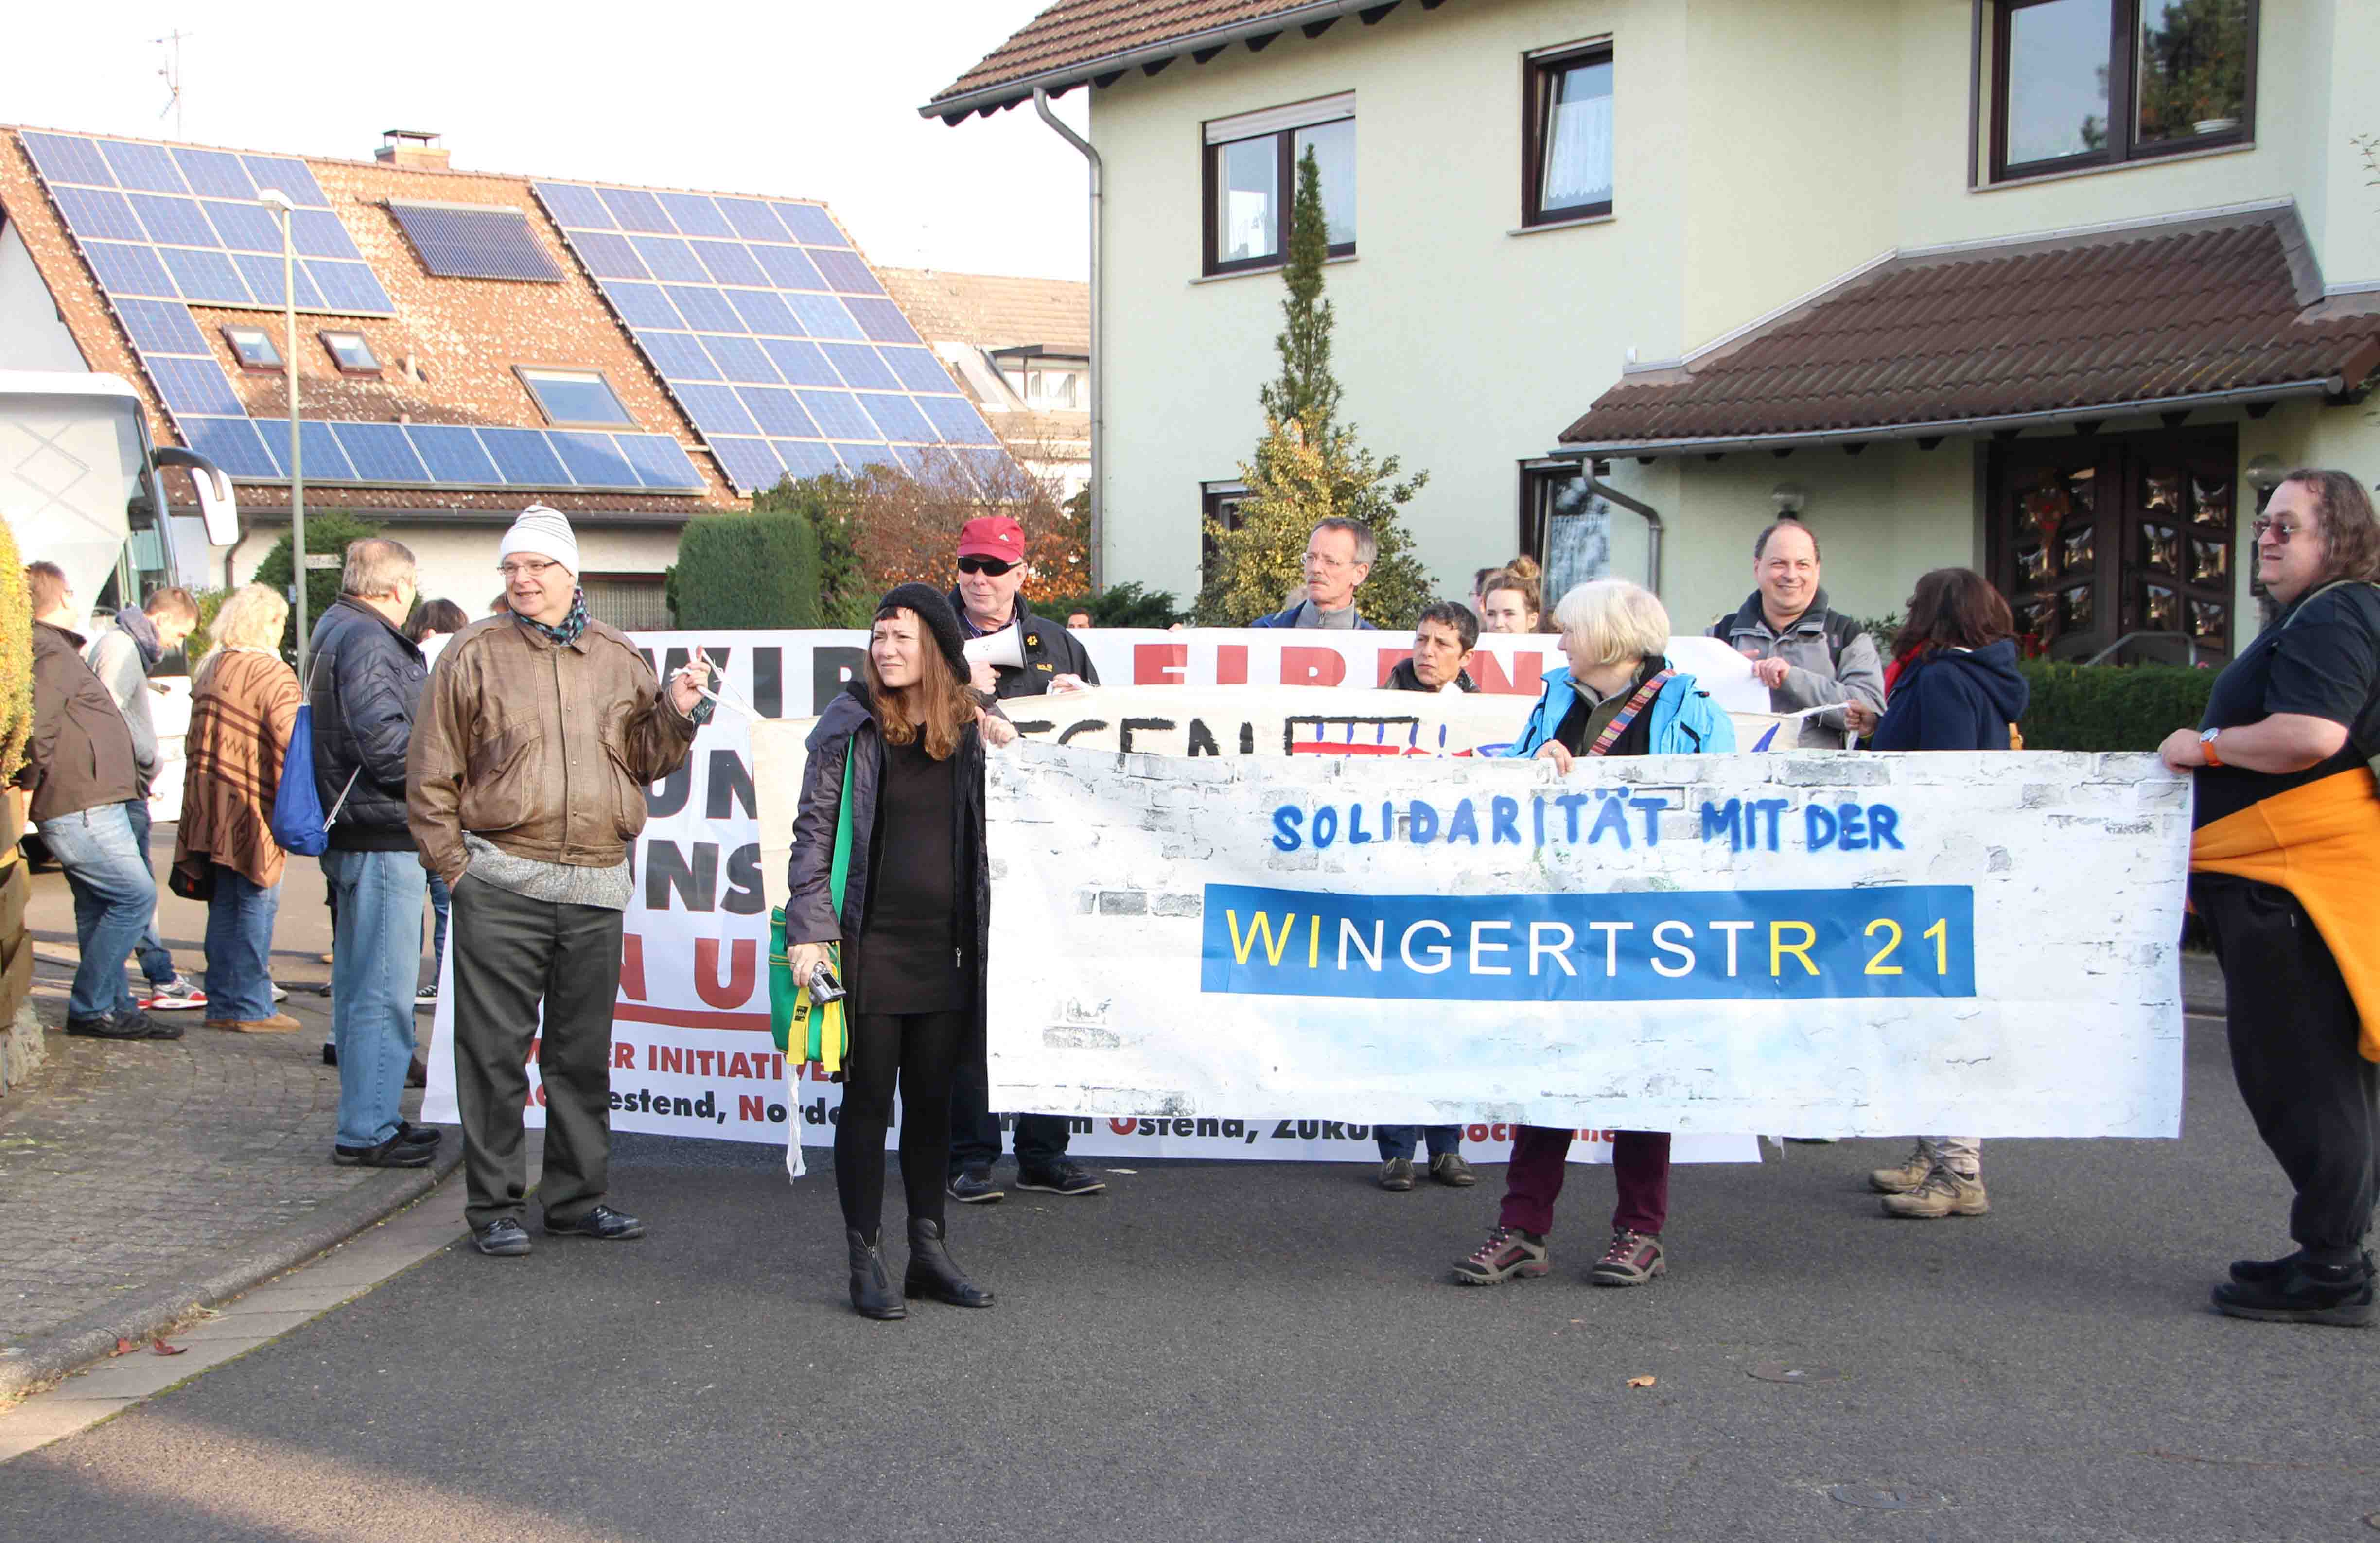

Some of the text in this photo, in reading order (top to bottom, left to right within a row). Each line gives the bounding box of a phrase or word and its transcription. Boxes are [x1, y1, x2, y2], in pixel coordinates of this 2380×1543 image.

[1272, 786, 1905, 853] SOLIDARITÄT MIT DER
[1226, 909, 1949, 978] WINGERTSTR 21
